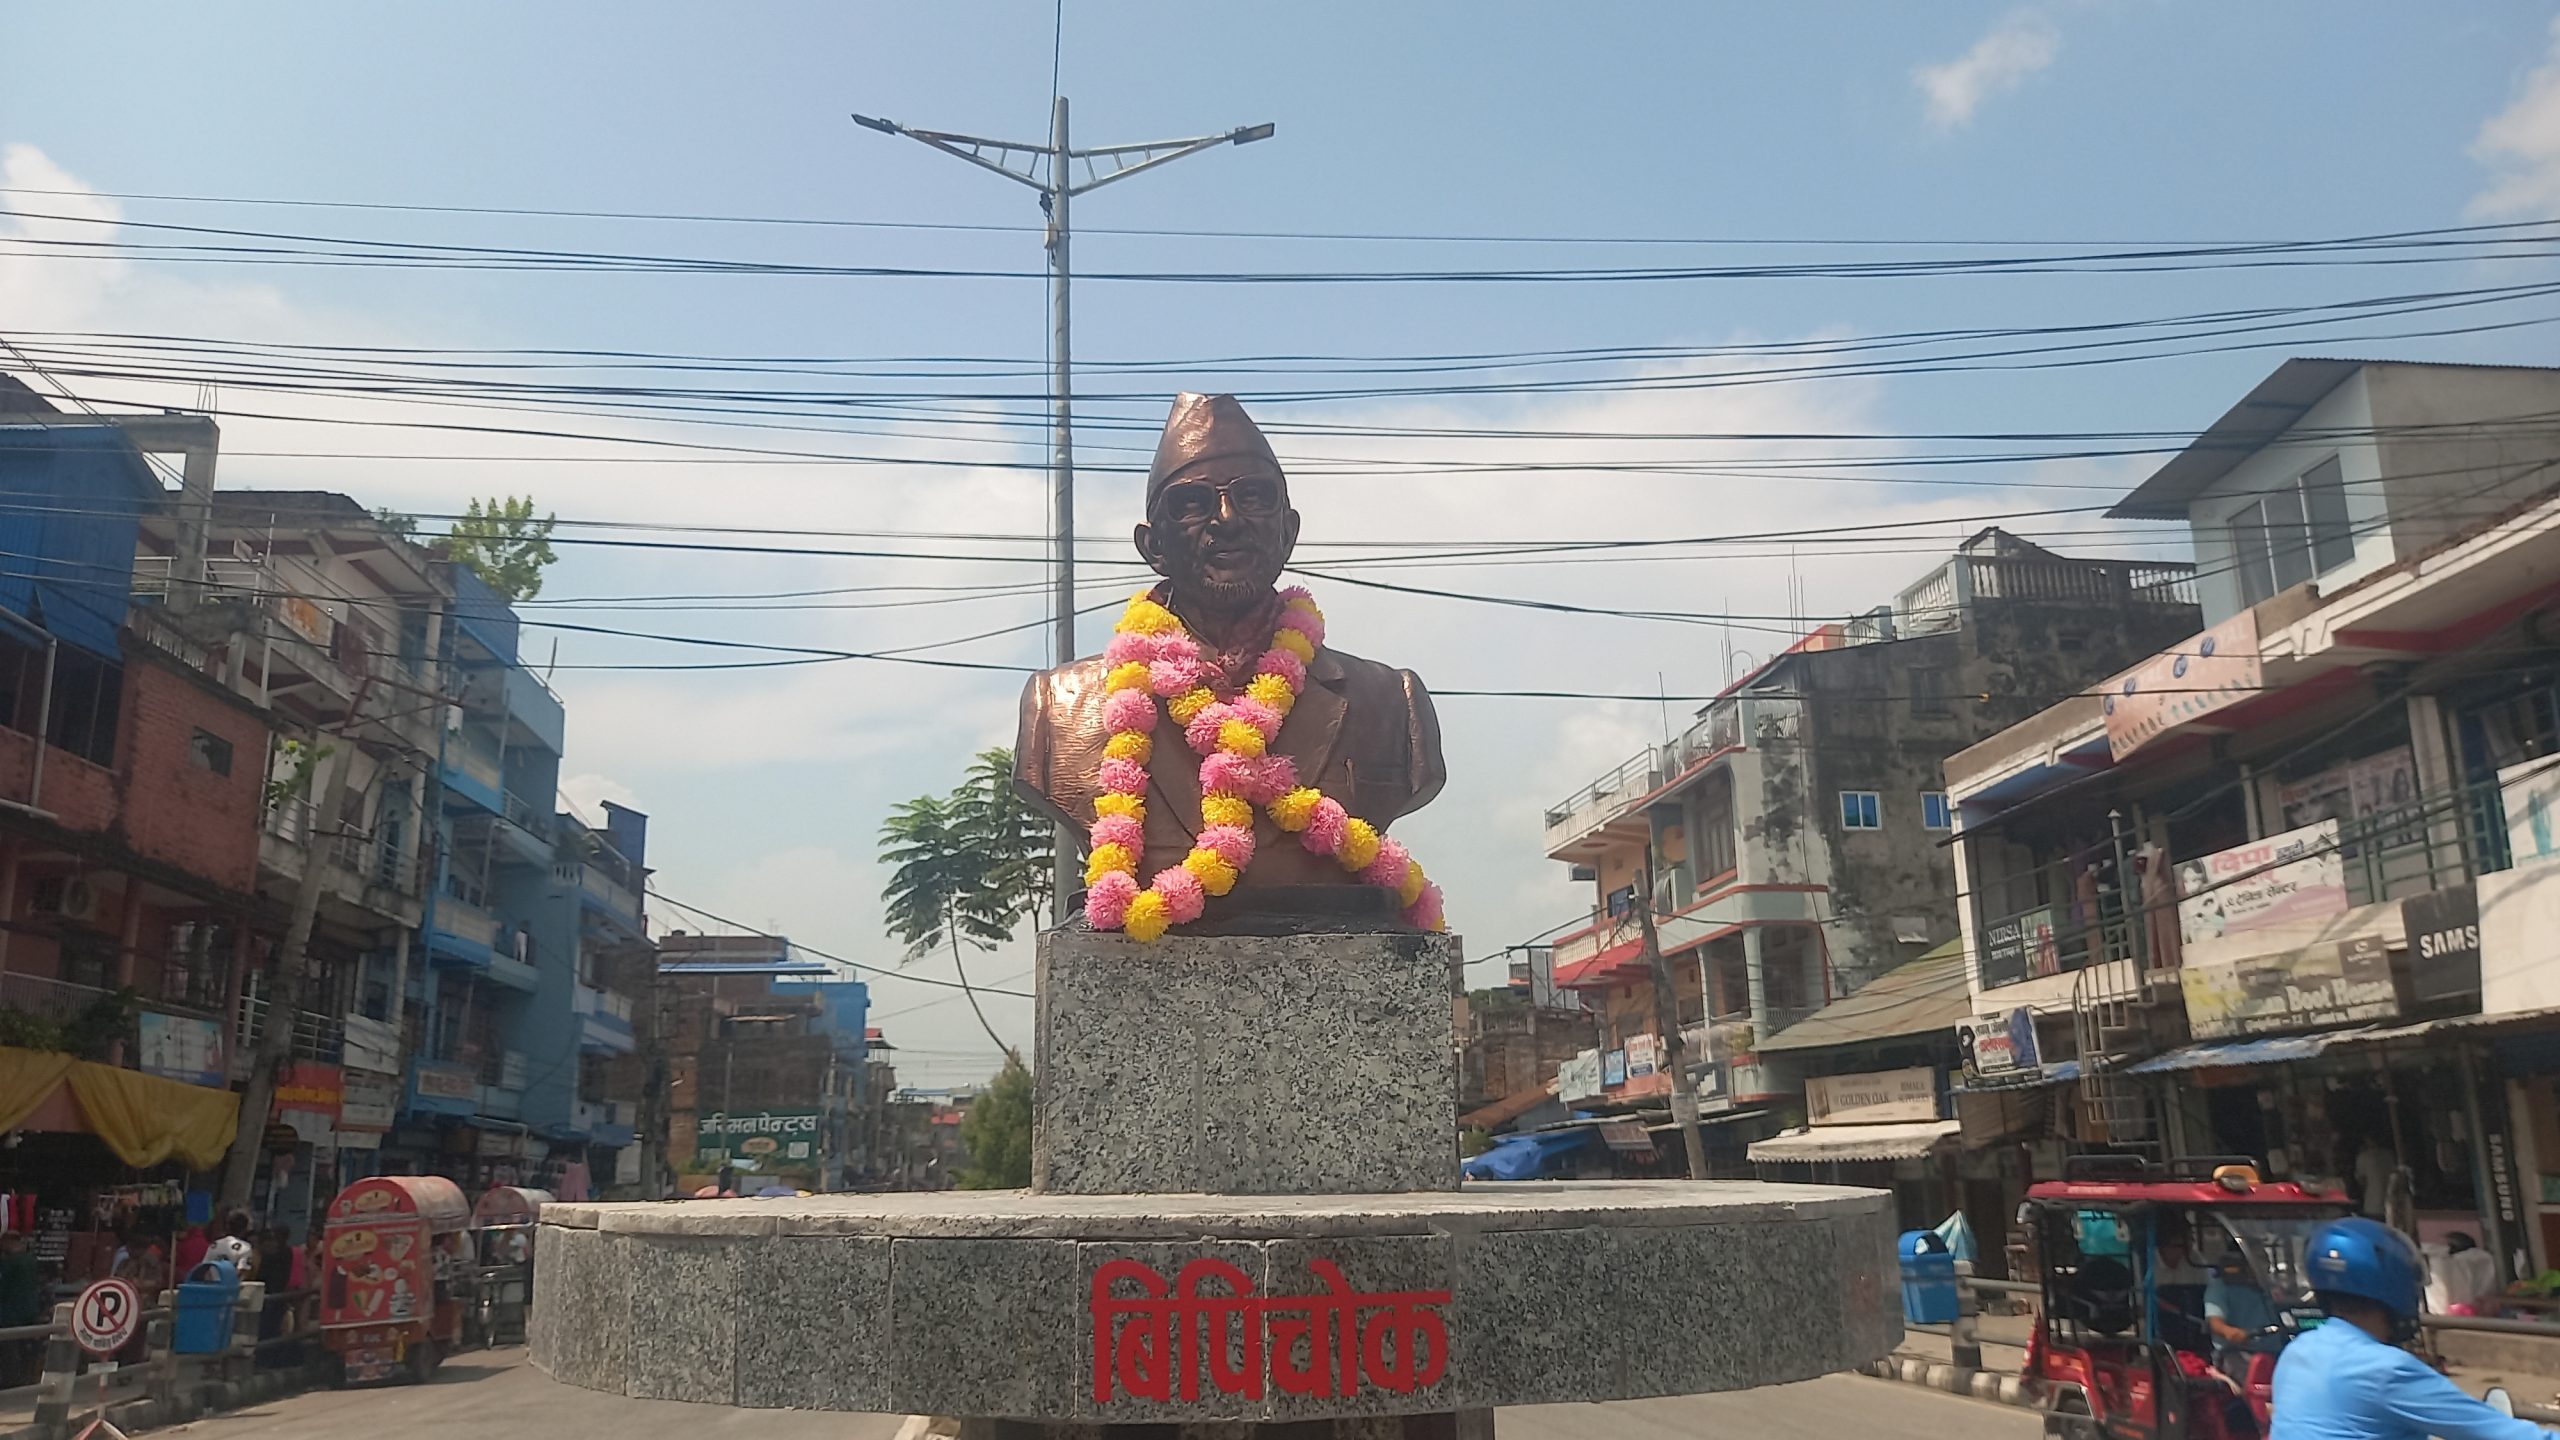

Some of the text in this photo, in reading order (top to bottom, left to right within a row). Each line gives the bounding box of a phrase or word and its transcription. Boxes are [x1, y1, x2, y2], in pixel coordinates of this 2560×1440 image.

[1988, 923, 2021, 947] NIRSA
[2285, 983, 2332, 1012] Boot
[1839, 1091, 1889, 1107] GOLDEN OAK
